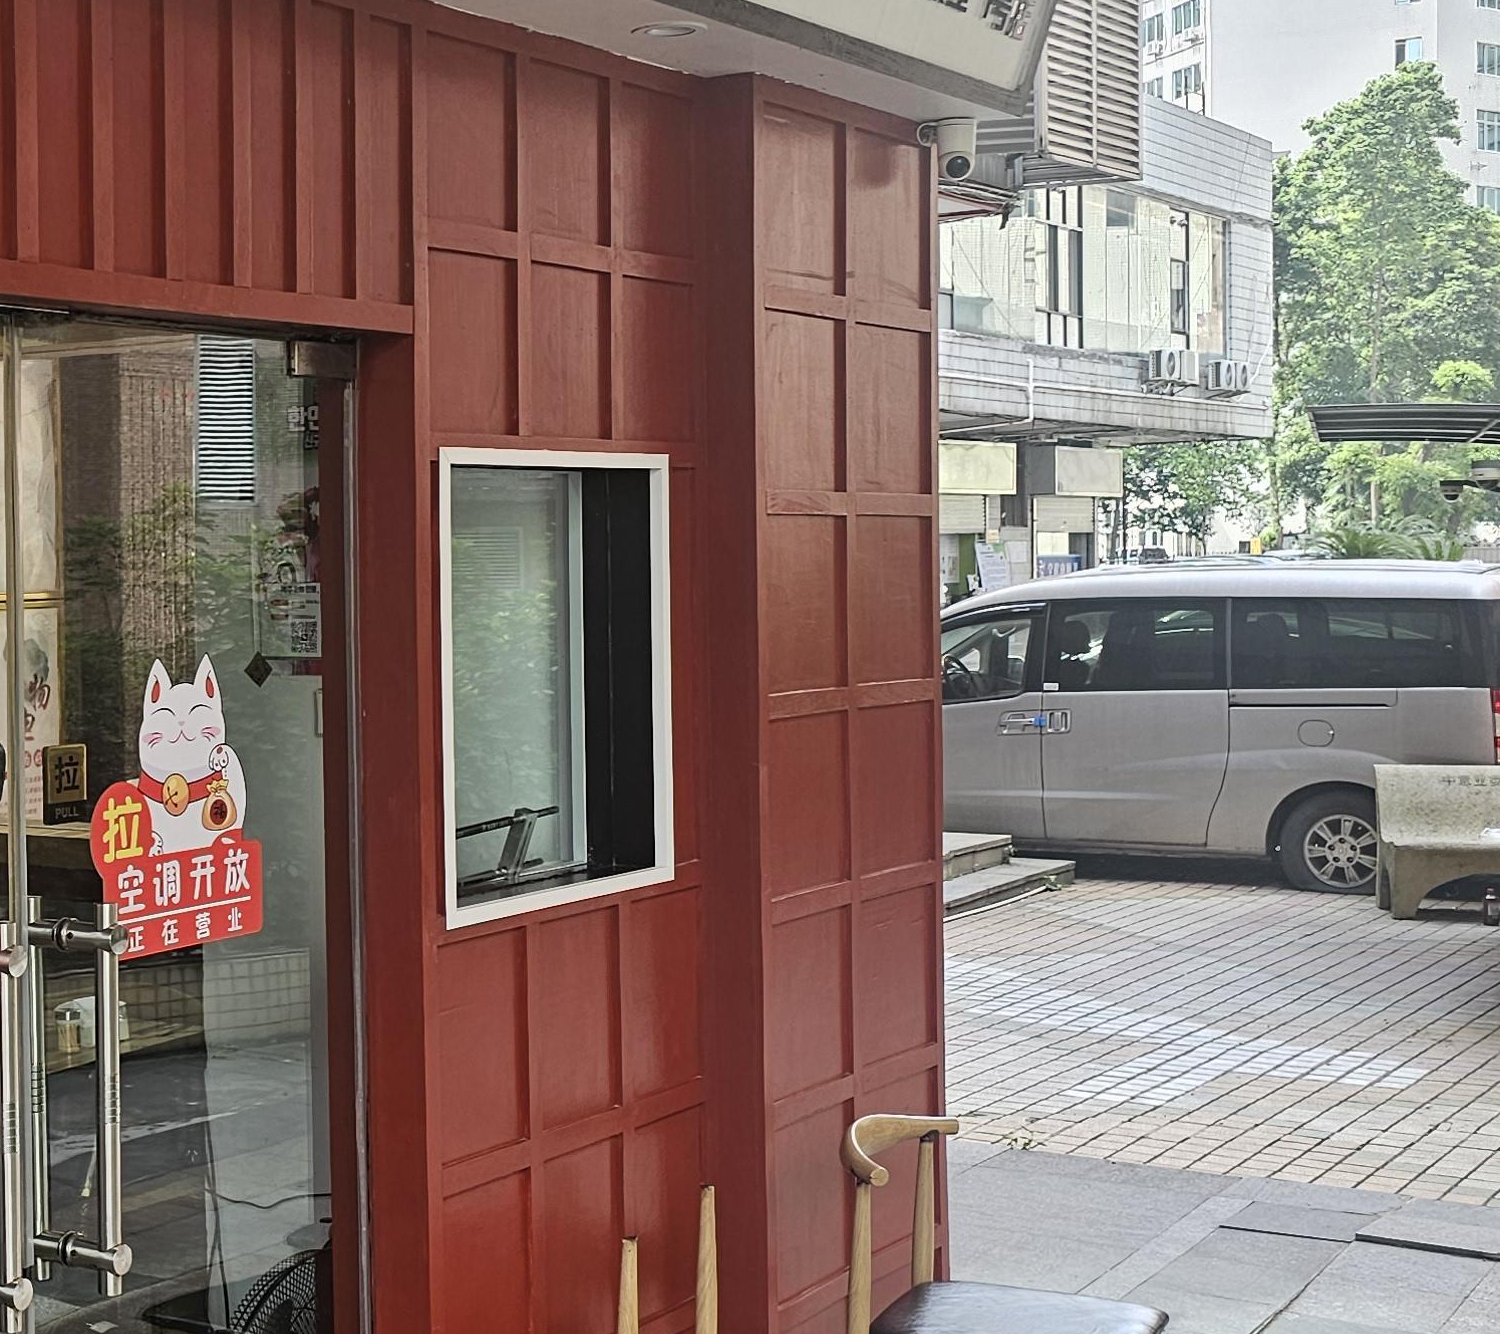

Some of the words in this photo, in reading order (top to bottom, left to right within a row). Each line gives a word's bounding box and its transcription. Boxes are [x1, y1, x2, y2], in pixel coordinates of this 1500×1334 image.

[55, 755, 80, 795] 拉
[55, 805, 80, 820] PULL
[102, 795, 144, 864] 拉
[117, 848, 251, 915] 空调开放
[128, 906, 244, 953] 正在营业
